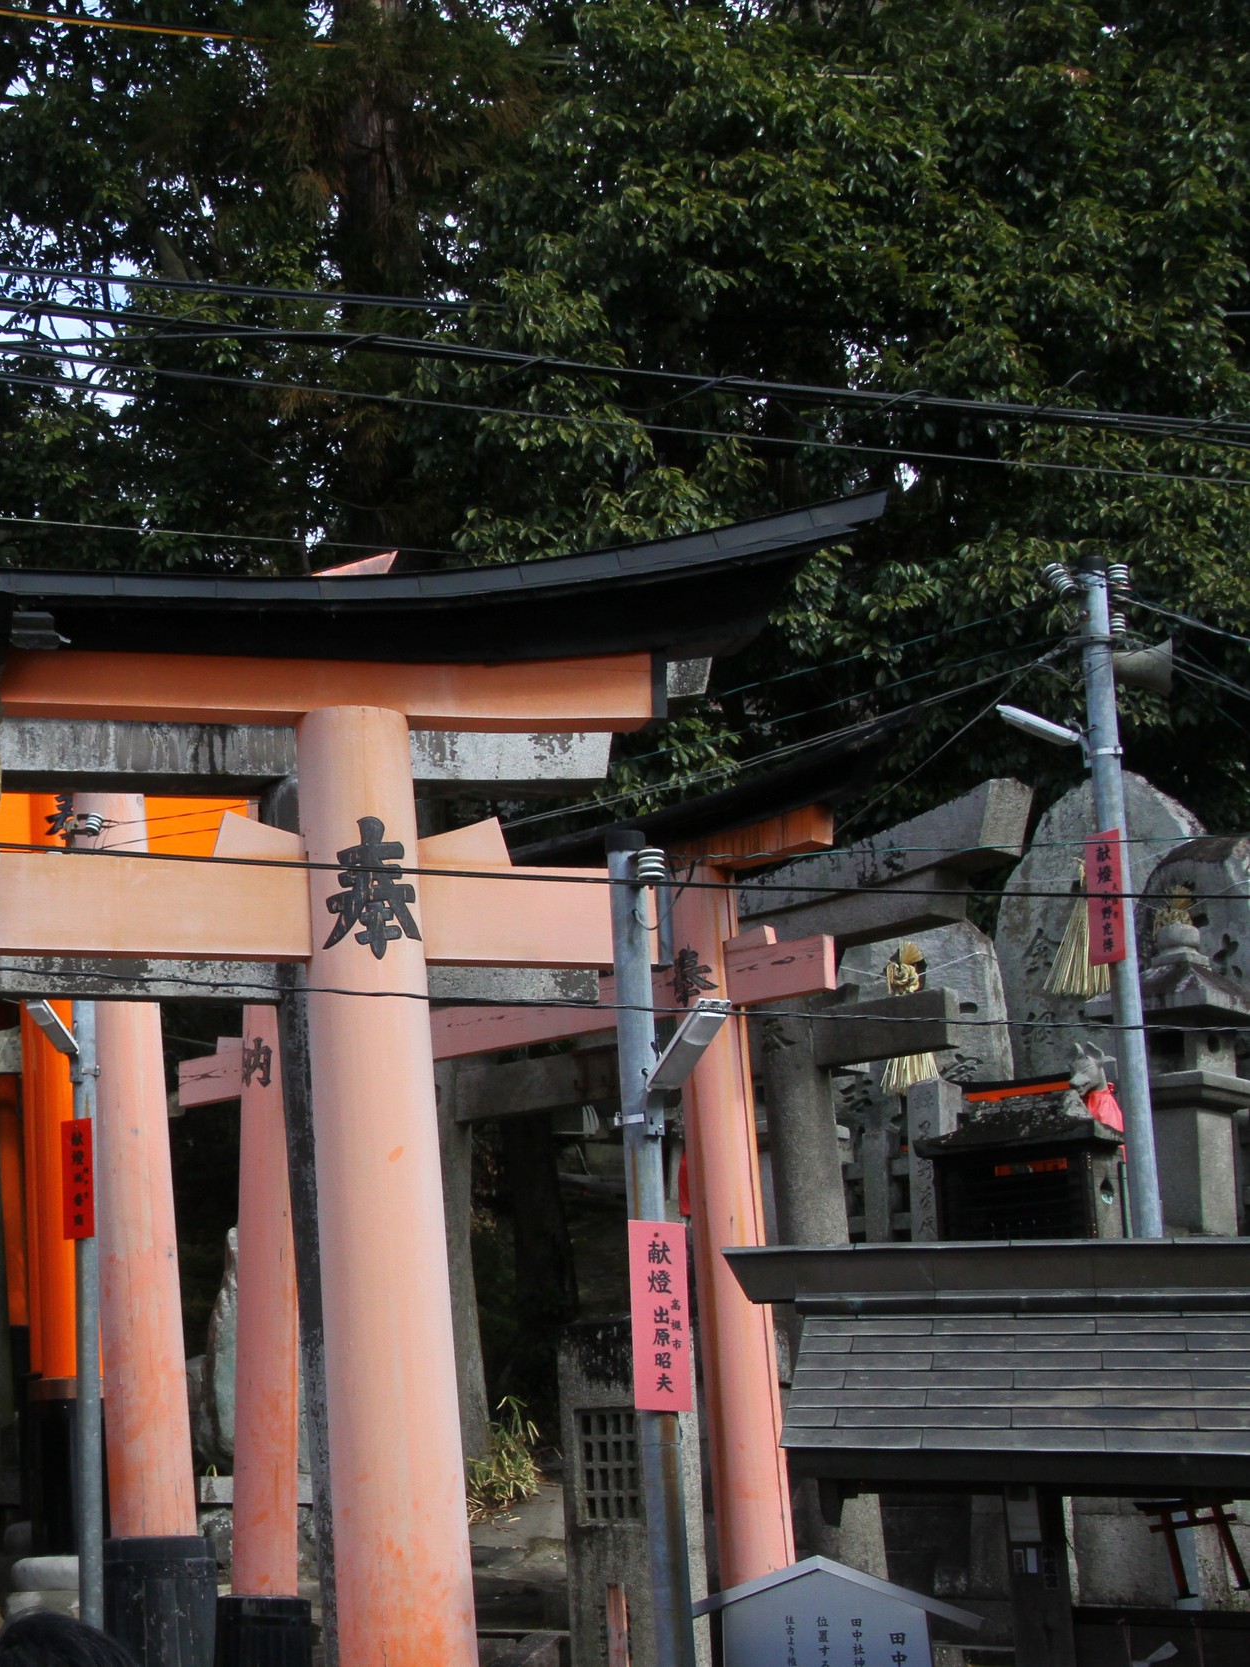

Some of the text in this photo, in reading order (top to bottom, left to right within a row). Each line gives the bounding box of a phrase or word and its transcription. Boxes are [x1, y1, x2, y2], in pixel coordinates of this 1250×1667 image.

[322, 816, 423, 960] 奉
[648, 1240, 672, 1295] 献燈
[653, 1305, 675, 1393] 出原昭夫
[670, 1298, 683, 1351] 高槻市
[889, 1632, 908, 1667] 田中
